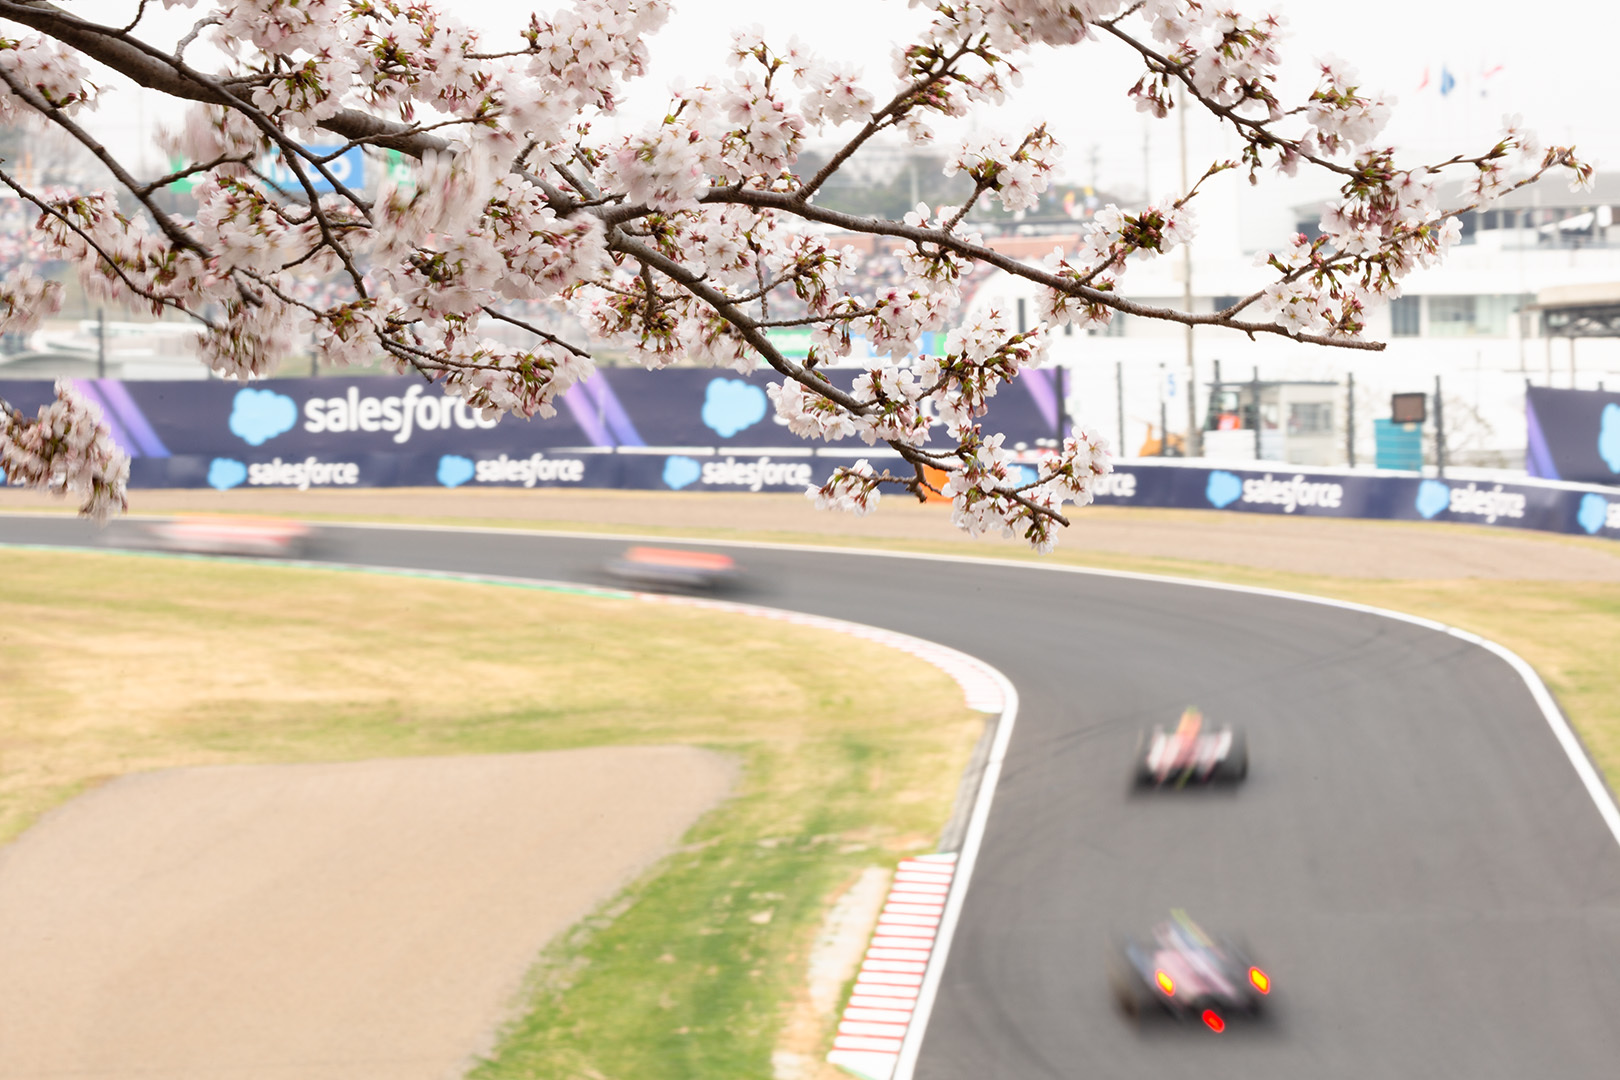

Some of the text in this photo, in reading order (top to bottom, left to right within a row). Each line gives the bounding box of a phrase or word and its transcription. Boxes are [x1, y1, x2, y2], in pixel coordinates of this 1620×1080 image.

[248, 456, 359, 491] salesforce
[475, 453, 584, 488] salesforce
[702, 456, 812, 492] salesforce
[1242, 473, 1343, 513] salesforce
